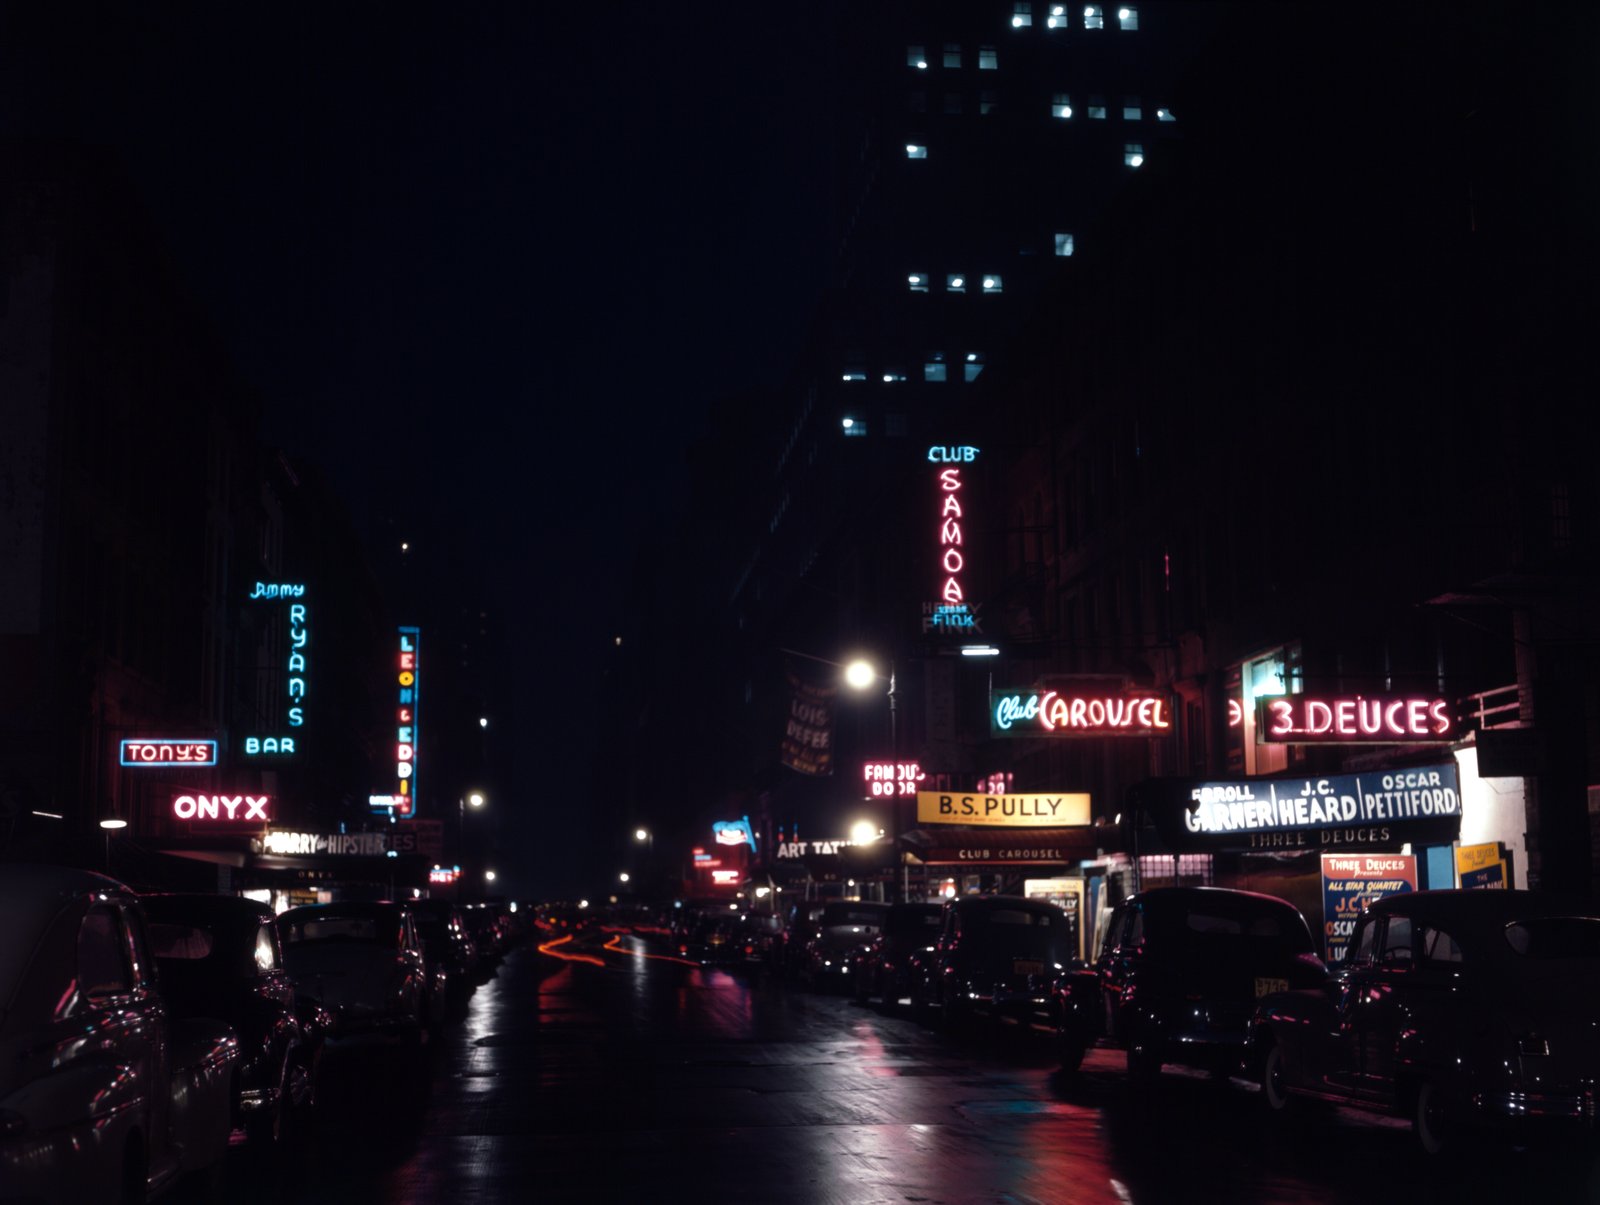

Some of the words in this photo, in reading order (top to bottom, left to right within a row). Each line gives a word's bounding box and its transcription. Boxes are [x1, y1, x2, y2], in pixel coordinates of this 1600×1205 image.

[927, 446, 980, 463] CLUB
[940, 469, 964, 602] SAMOA
[289, 604, 306, 726] RYAN'S
[398, 635, 415, 704] LEON
[996, 695, 1039, 729] Club
[1039, 692, 1169, 730] CAROUSEL
[1270, 701, 1293, 733] 3
[1308, 699, 1450, 735] DEUCES
[128, 745, 208, 762] TONY'S
[245, 738, 295, 754] BAR
[1301, 780, 1334, 796] J.C.
[1382, 772, 1441, 790] OSCAR
[174, 796, 269, 820] ONYX
[939, 796, 979, 815] B.S.
[985, 798, 1062, 816] PULLY
[1279, 796, 1357, 824] HEARD
[1366, 788, 1458, 820] PETTIFORD
[1250, 833, 1306, 848] THREE
[1321, 827, 1391, 844] DEUCES
[777, 843, 807, 858] ART
[959, 850, 990, 859] CLUB
[999, 849, 1062, 859] CAROUSEL
[1329, 859, 1360, 871] THREE
[1366, 859, 1405, 871] DEUCES
[1328, 882, 1343, 891] ALL
[1345, 882, 1364, 891] STAR
[1367, 881, 1404, 894] QUARTET
[1335, 897, 1361, 912] J.C.
[1325, 921, 1357, 936] OSCA
